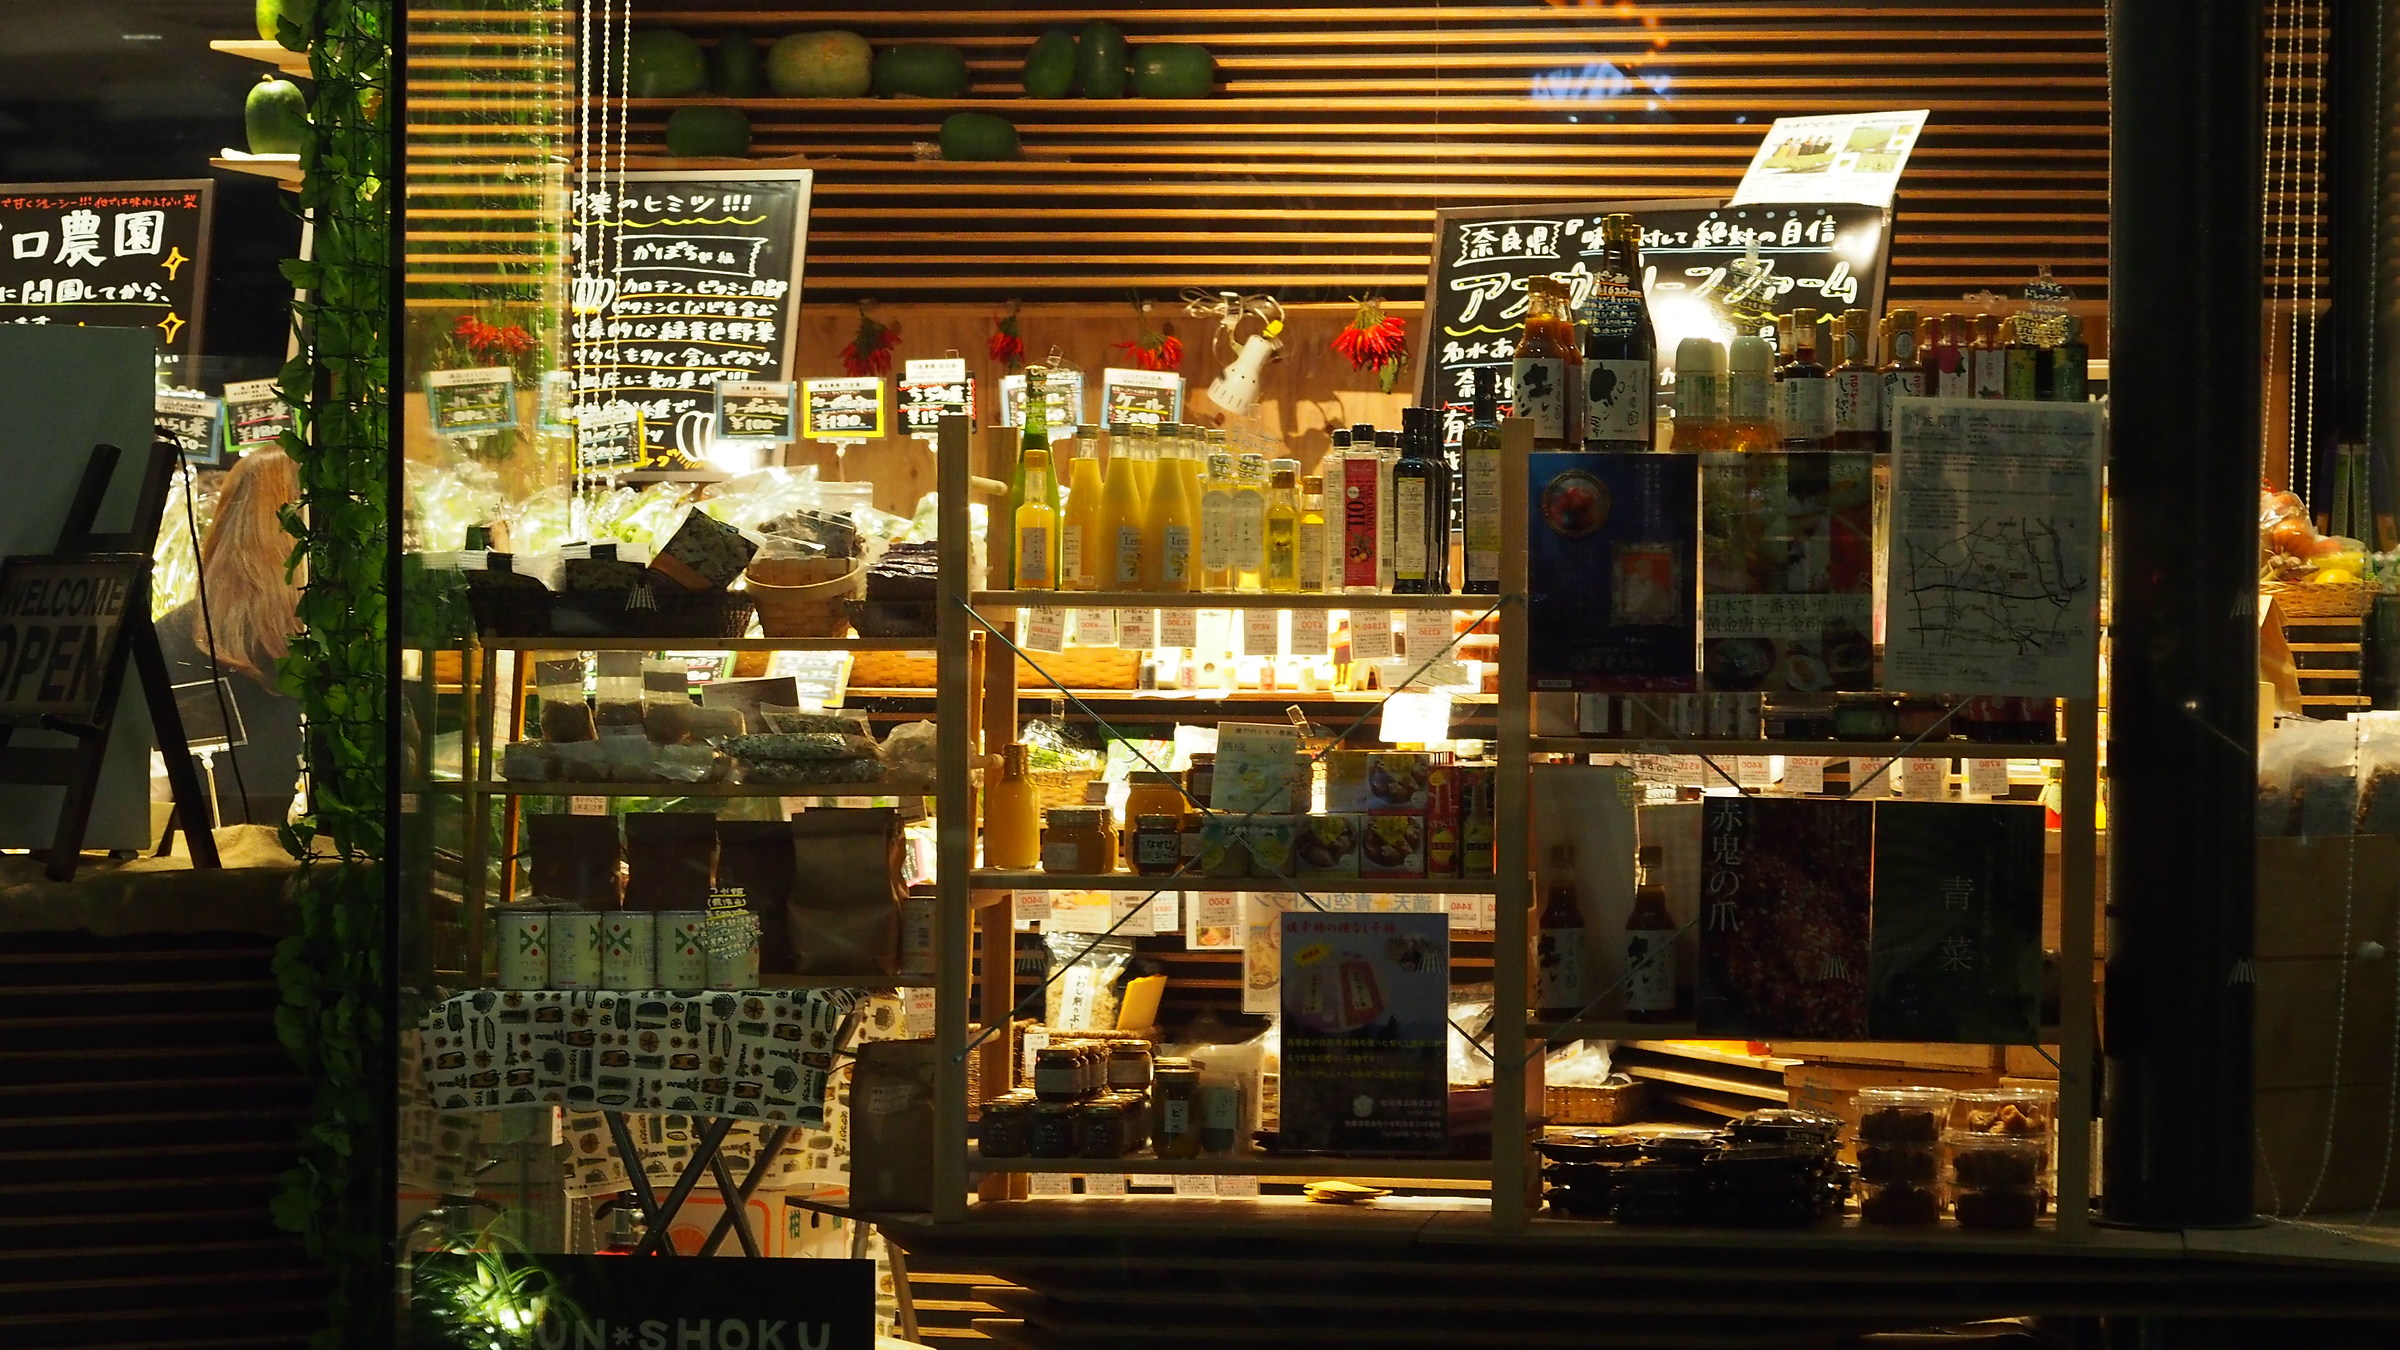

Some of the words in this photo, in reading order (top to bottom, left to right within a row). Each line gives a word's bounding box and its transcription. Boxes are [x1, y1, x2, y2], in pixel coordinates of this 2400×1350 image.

[1470, 226, 1549, 259] 奈良県
[1440, 337, 1515, 364] 名水あ
[2, 577, 124, 616] WELCOME
[1708, 798, 1745, 933] 赤鬼の爪
